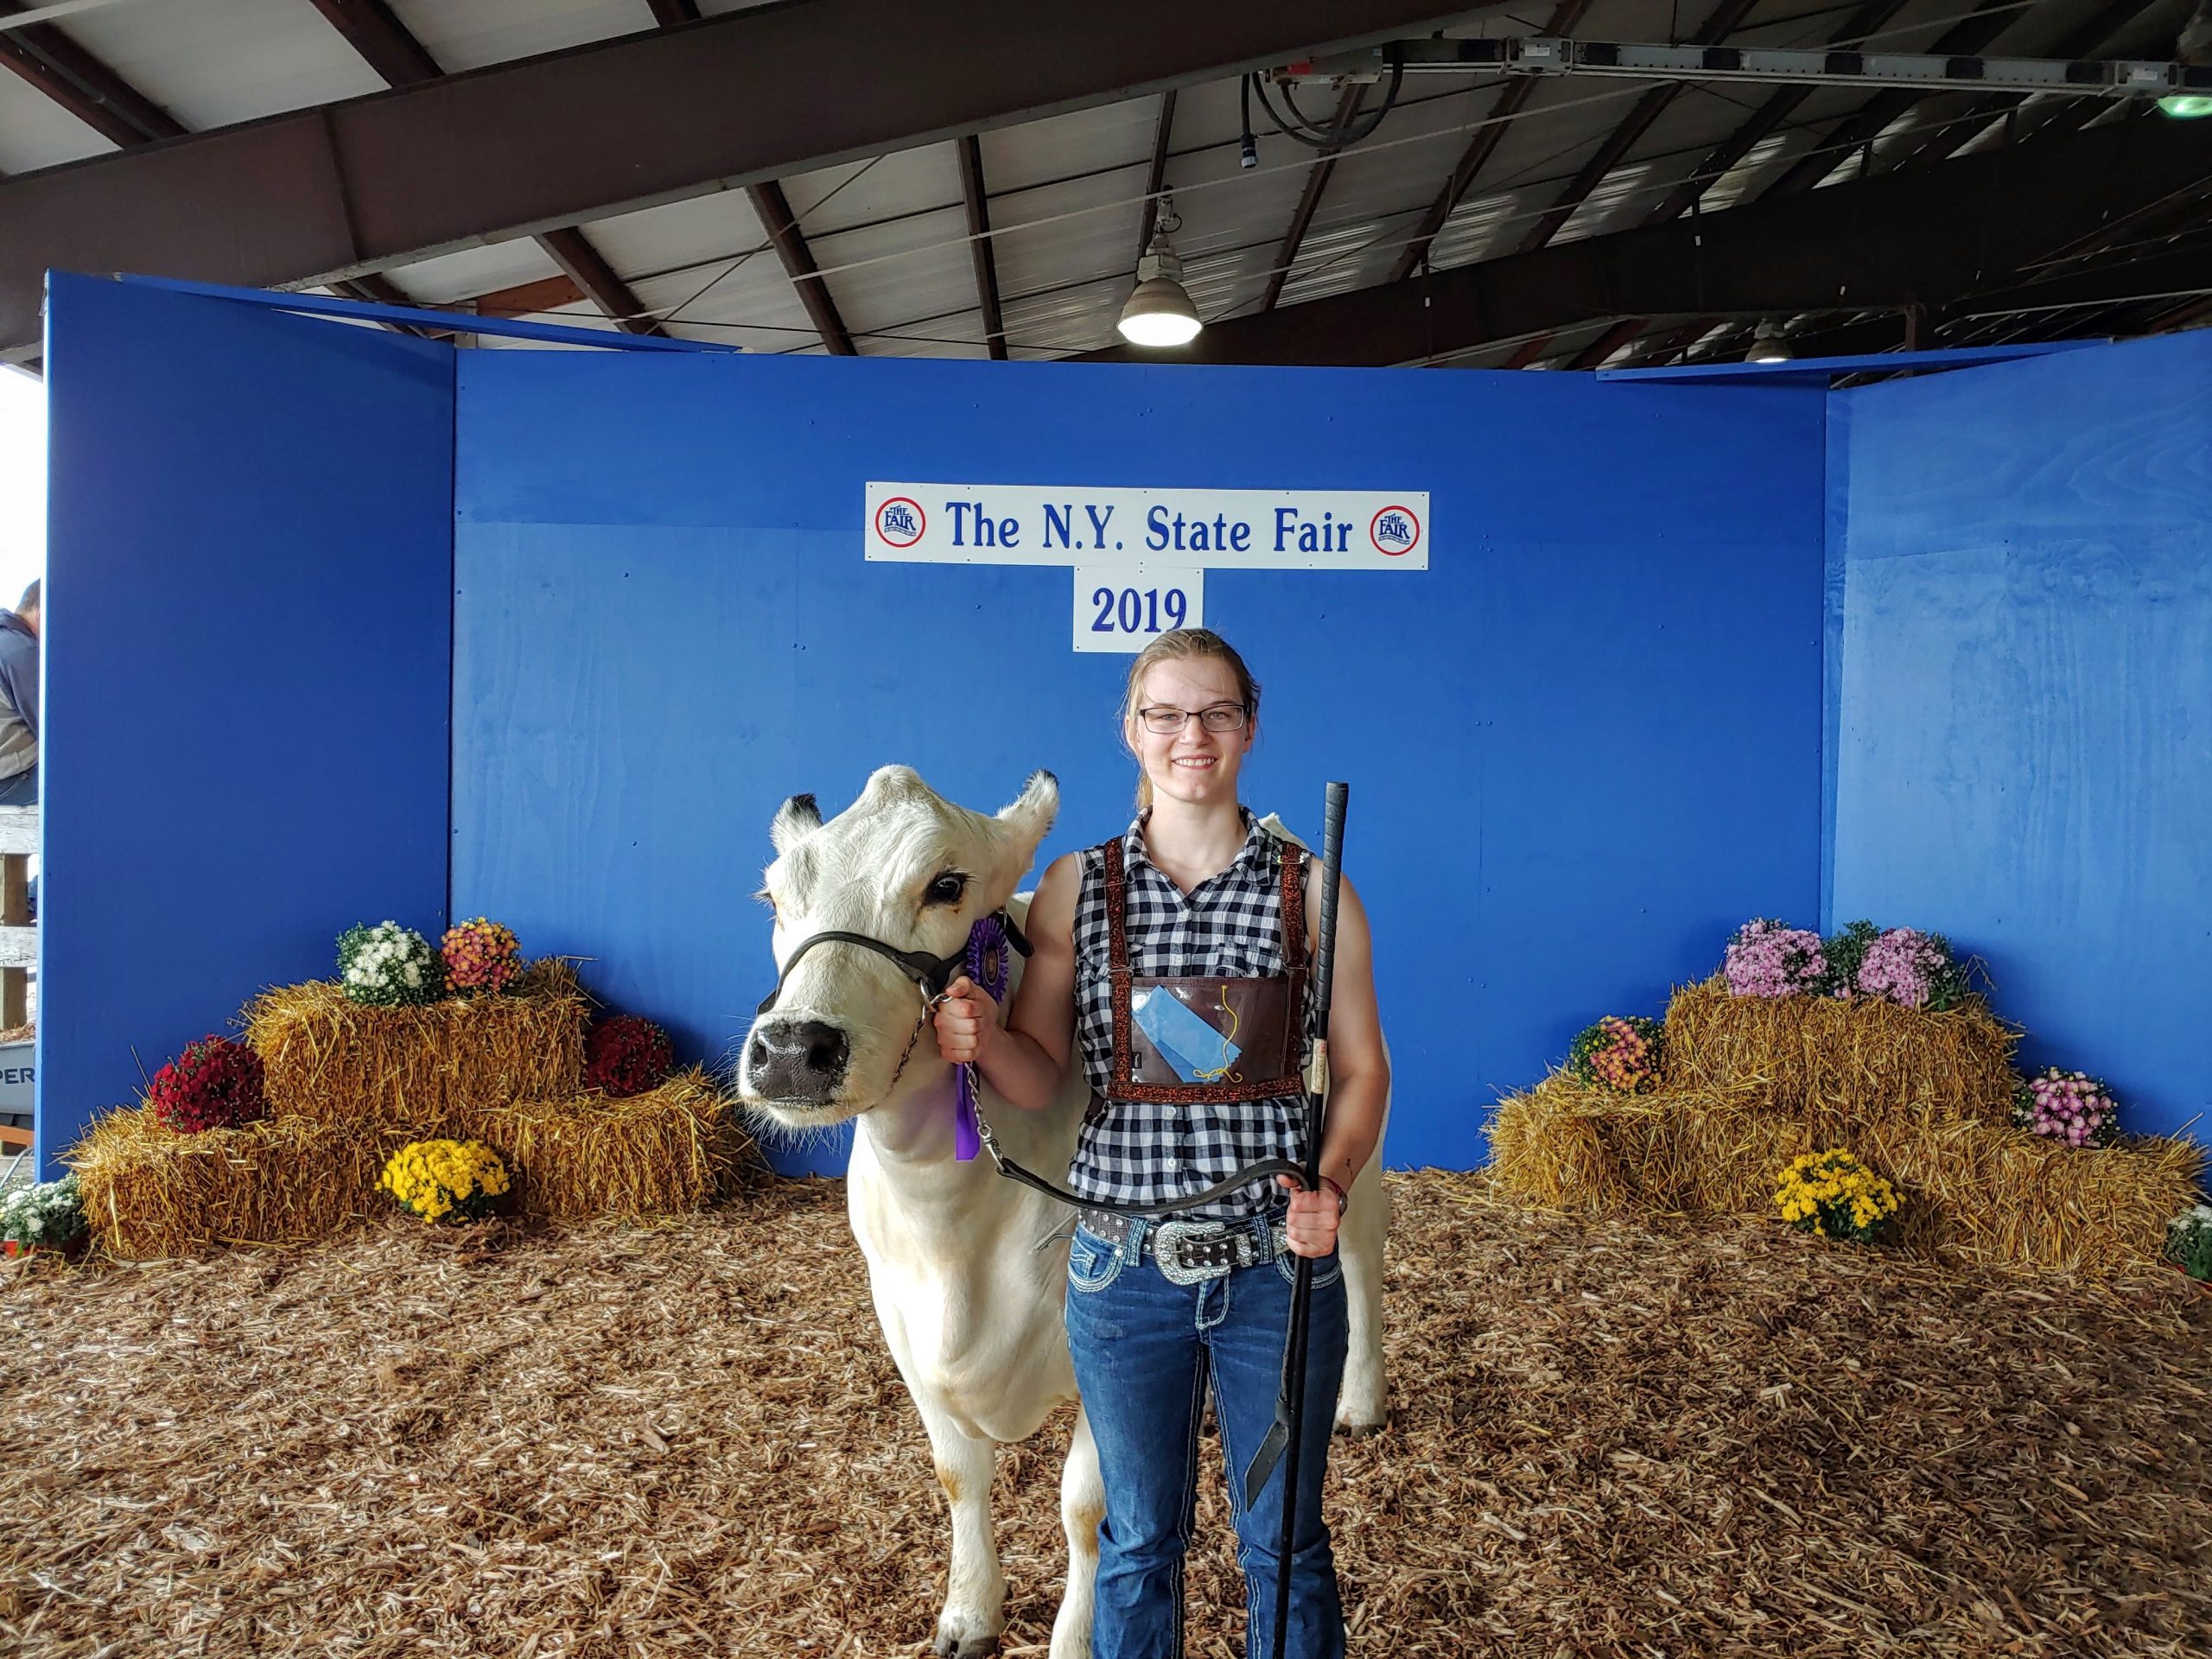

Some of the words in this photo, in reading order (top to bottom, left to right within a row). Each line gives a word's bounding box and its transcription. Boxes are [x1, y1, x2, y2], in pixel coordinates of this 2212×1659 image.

[890, 505, 910, 516] THE
[1384, 513, 1404, 524] THE
[884, 511, 917, 531] FAIR
[945, 502, 1020, 548] The
[1043, 504, 1122, 550] N.Y.
[1146, 505, 1251, 551] State
[1274, 508, 1353, 552] Fair
[1379, 519, 1410, 539] FAIR
[1091, 588, 1186, 633] 2019
[0, 1068, 35, 1084] ER
